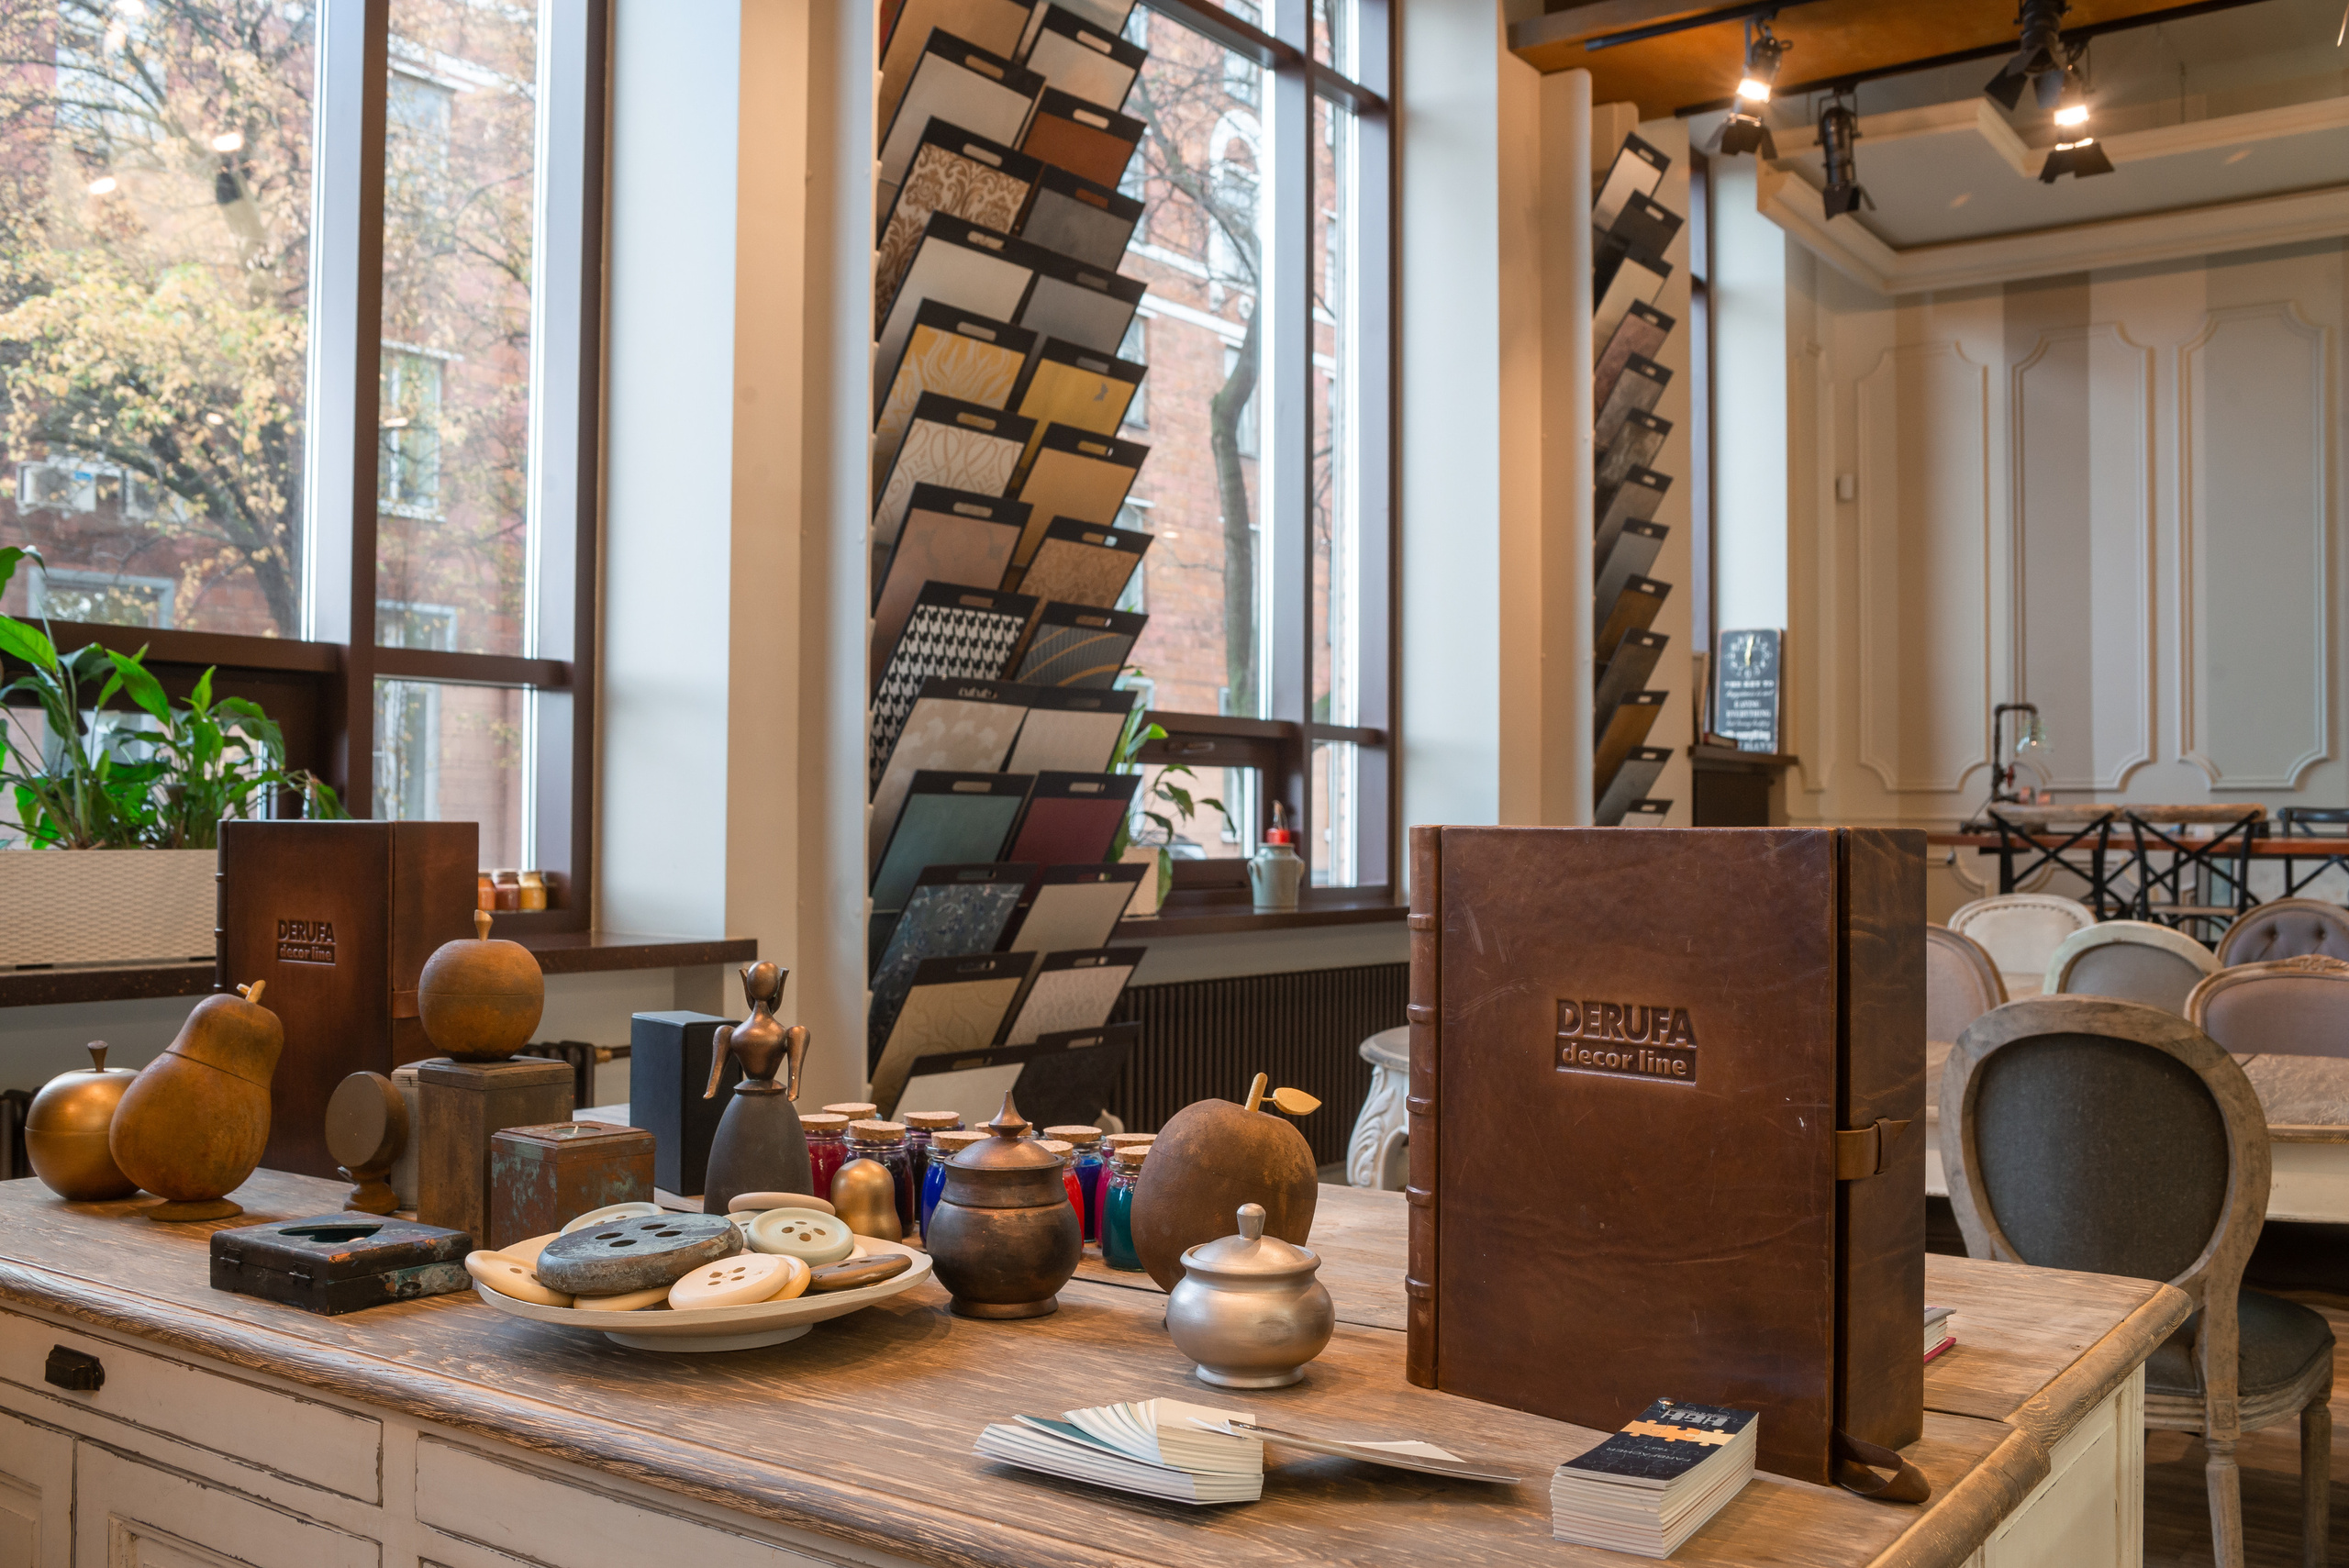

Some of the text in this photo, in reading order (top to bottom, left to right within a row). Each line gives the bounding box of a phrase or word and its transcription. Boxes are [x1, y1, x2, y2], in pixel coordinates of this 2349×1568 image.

[277, 919, 337, 945] DERUFA
[280, 944, 332, 961] decor line
[1557, 998, 1697, 1049] DERUFA
[1562, 1042, 1687, 1076] decor line
